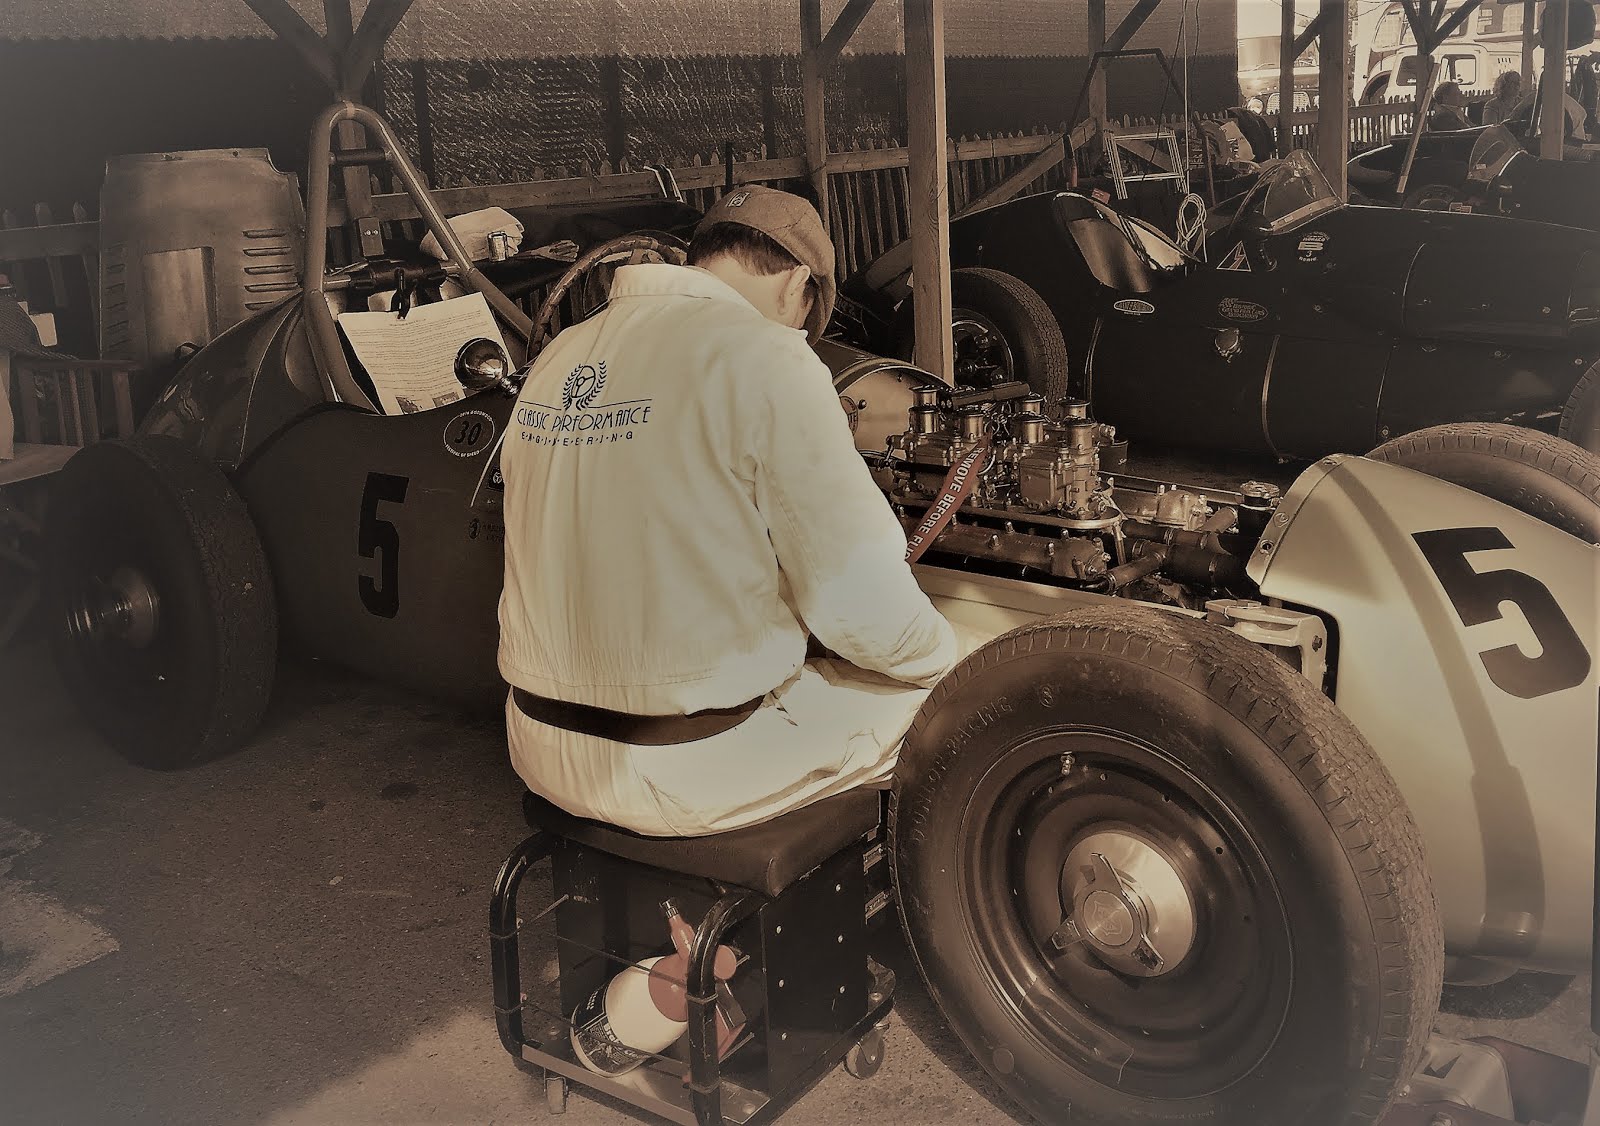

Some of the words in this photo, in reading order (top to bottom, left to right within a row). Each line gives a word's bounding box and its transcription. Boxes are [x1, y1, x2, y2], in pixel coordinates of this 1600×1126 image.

[454, 421, 481, 445] 30
[517, 408, 550, 430] CLASSIC
[950, 447, 985, 492] REMOVE
[918, 493, 956, 534] BEFORE
[358, 471, 410, 619] 5
[1411, 527, 1592, 699] 5
